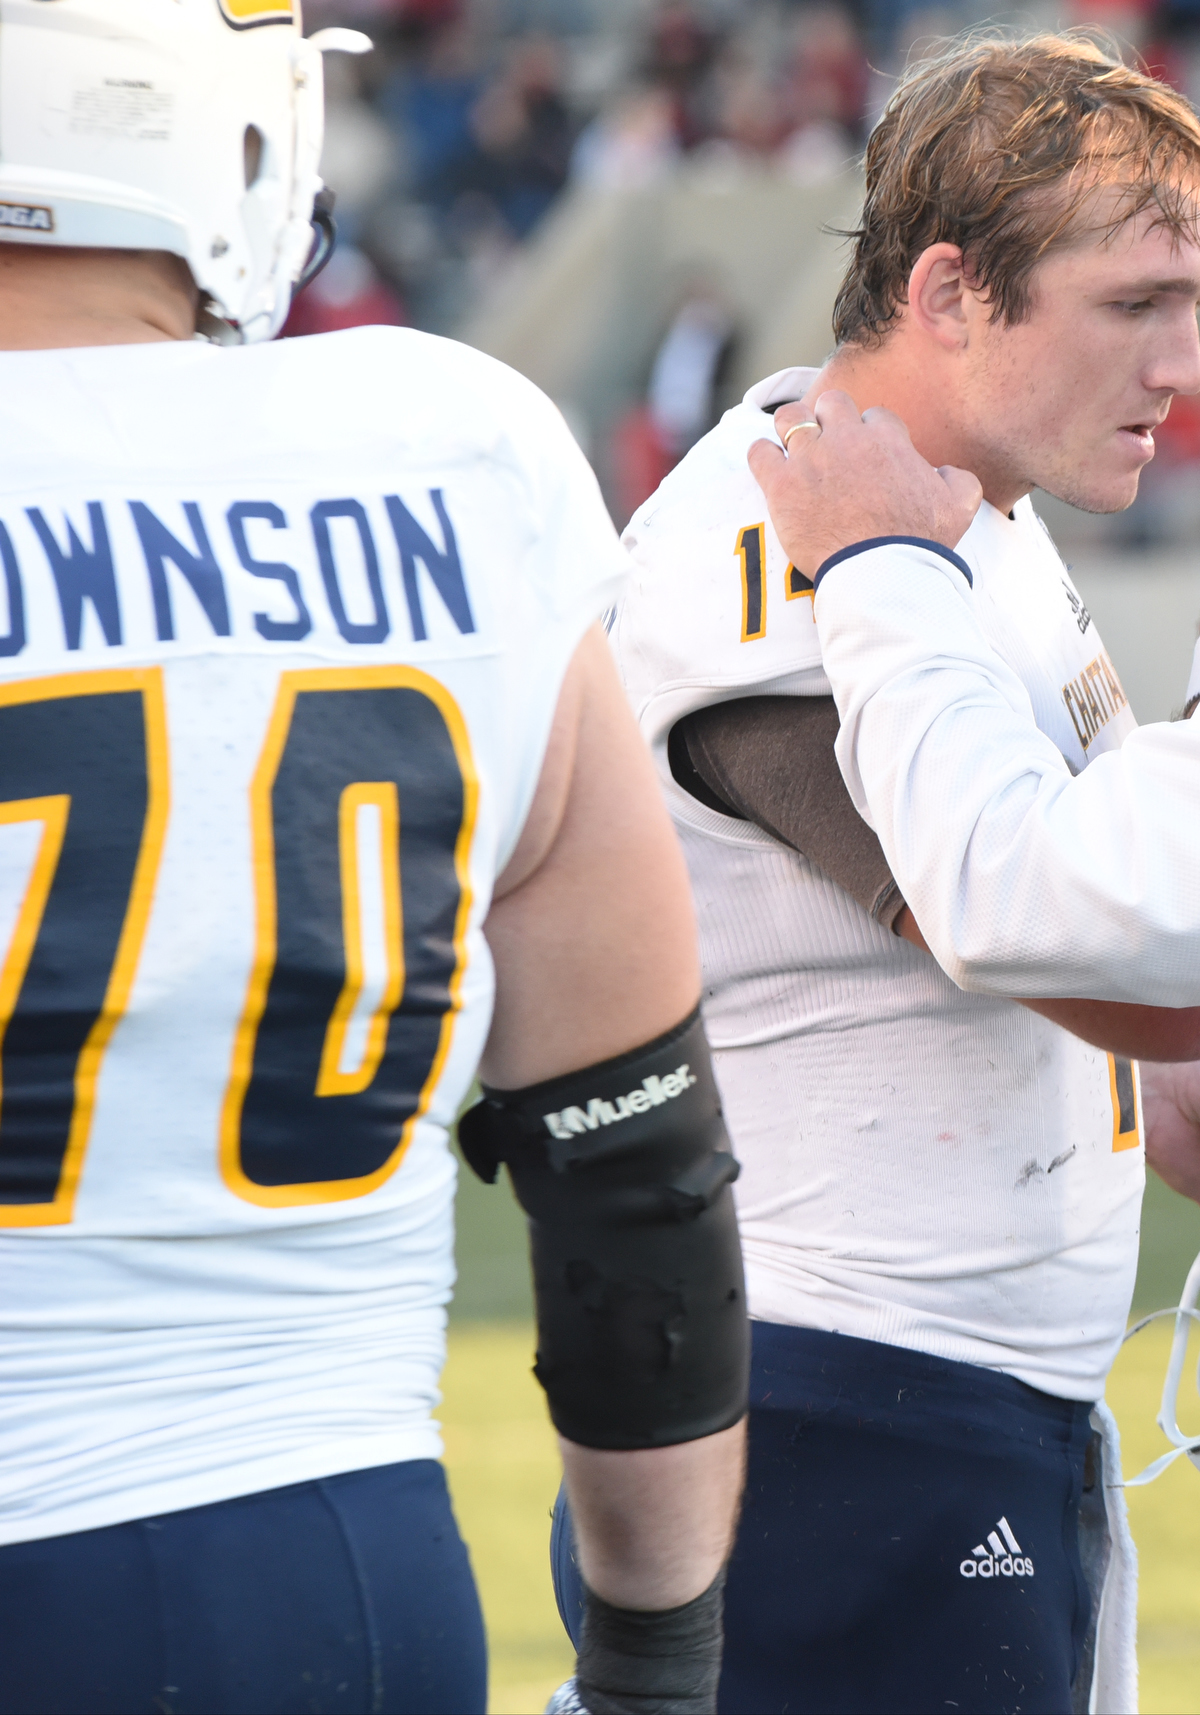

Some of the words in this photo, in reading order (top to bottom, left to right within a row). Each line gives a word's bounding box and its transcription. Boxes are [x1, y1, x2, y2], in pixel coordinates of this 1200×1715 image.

[733, 521, 817, 643] 1
[0, 664, 480, 1228] 70
[960, 1554, 1034, 1578] adidas
